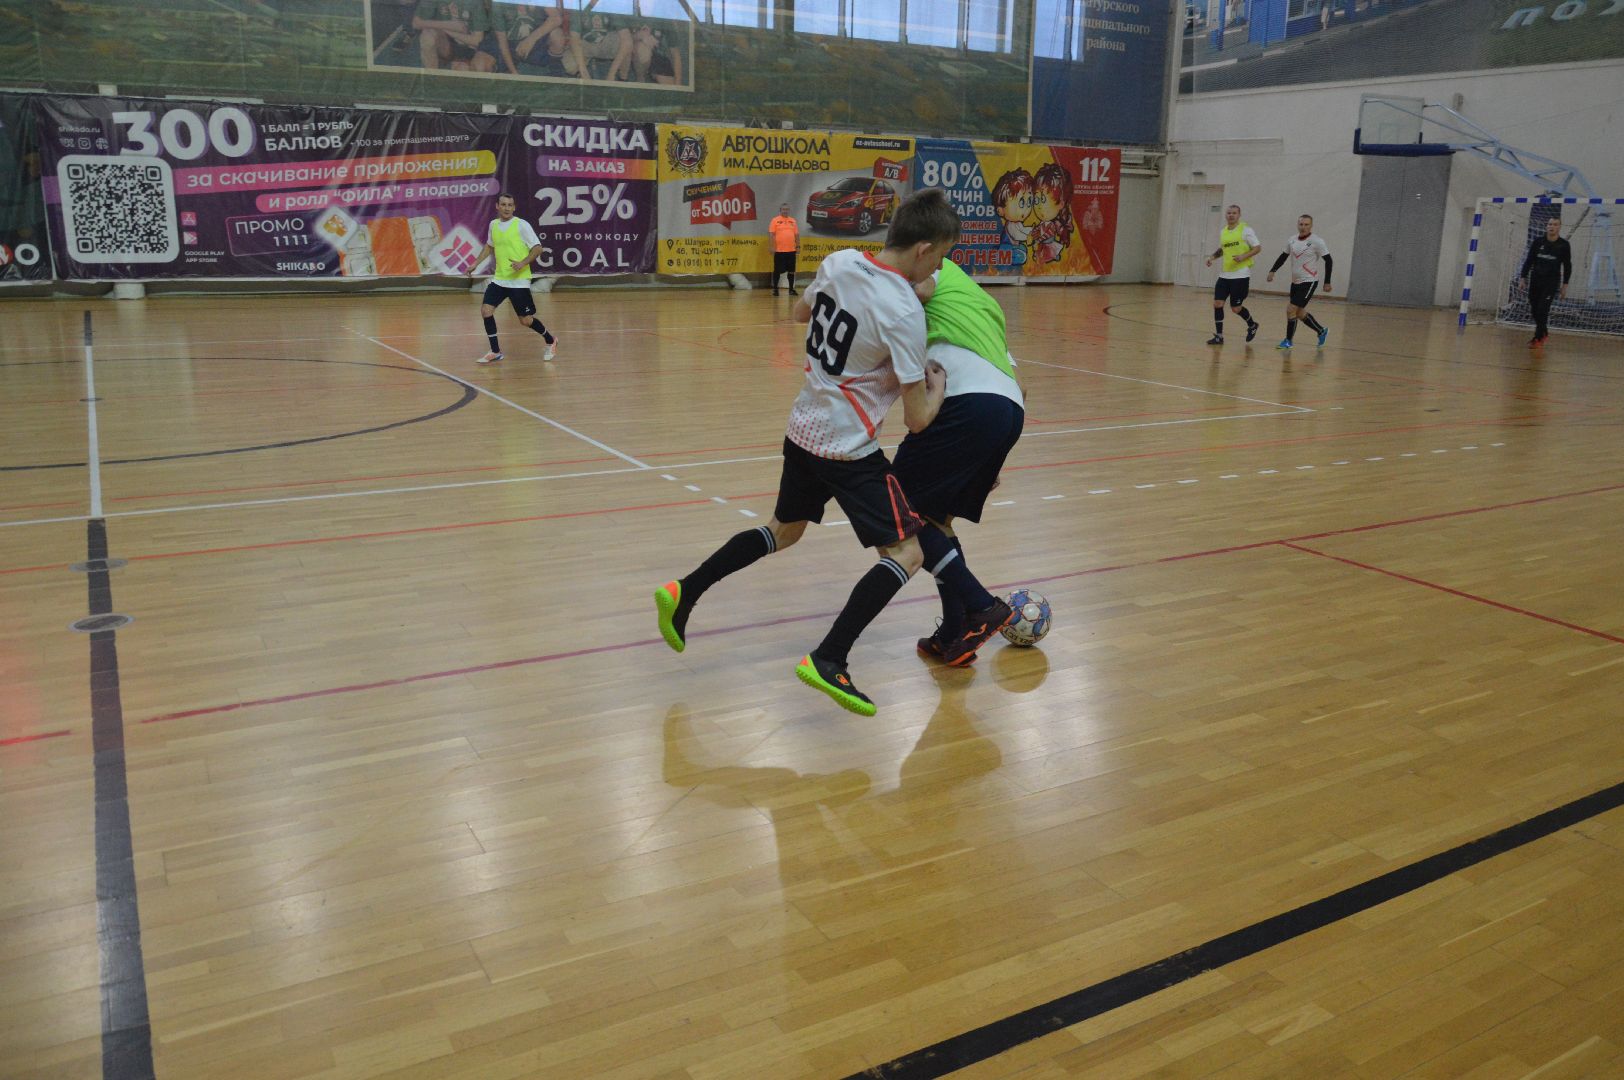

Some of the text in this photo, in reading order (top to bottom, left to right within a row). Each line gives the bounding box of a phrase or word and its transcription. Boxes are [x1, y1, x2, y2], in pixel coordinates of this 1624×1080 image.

[1086, 36, 1126, 52] района
[112, 107, 254, 160] 300
[268, 122, 300, 133] БАЛЛ
[318, 121, 353, 131] РУБЛЬ
[264, 136, 343, 151] БАЛЛОВ
[384, 136, 444, 147] приглашение
[445, 134, 470, 143] друга
[523, 123, 650, 154] СКИДКА
[722, 134, 831, 156] АВТОШКОЛА
[187, 155, 478, 188] за скачивание приложения
[548, 159, 625, 173] НА ЗАКАЗ
[723, 156, 830, 170] им.Давыдова
[1079, 157, 1112, 182] 112
[922, 160, 983, 189] 80%
[269, 198, 280, 209] и
[285, 194, 328, 211] ролл
[405, 187, 416, 198] в
[418, 180, 489, 199] подарок
[534, 182, 635, 226] 25%
[943, 189, 983, 203] ИЧИН
[701, 198, 741, 217] 5000
[952, 204, 995, 217] АРОВ
[235, 217, 304, 236] ПРОМО
[273, 234, 309, 247] 1111
[555, 232, 640, 242] ПРОМОКОДУ
[536, 247, 630, 268] GOAL
[952, 249, 1013, 266] ОГНЕМ
[805, 291, 859, 377] 69
